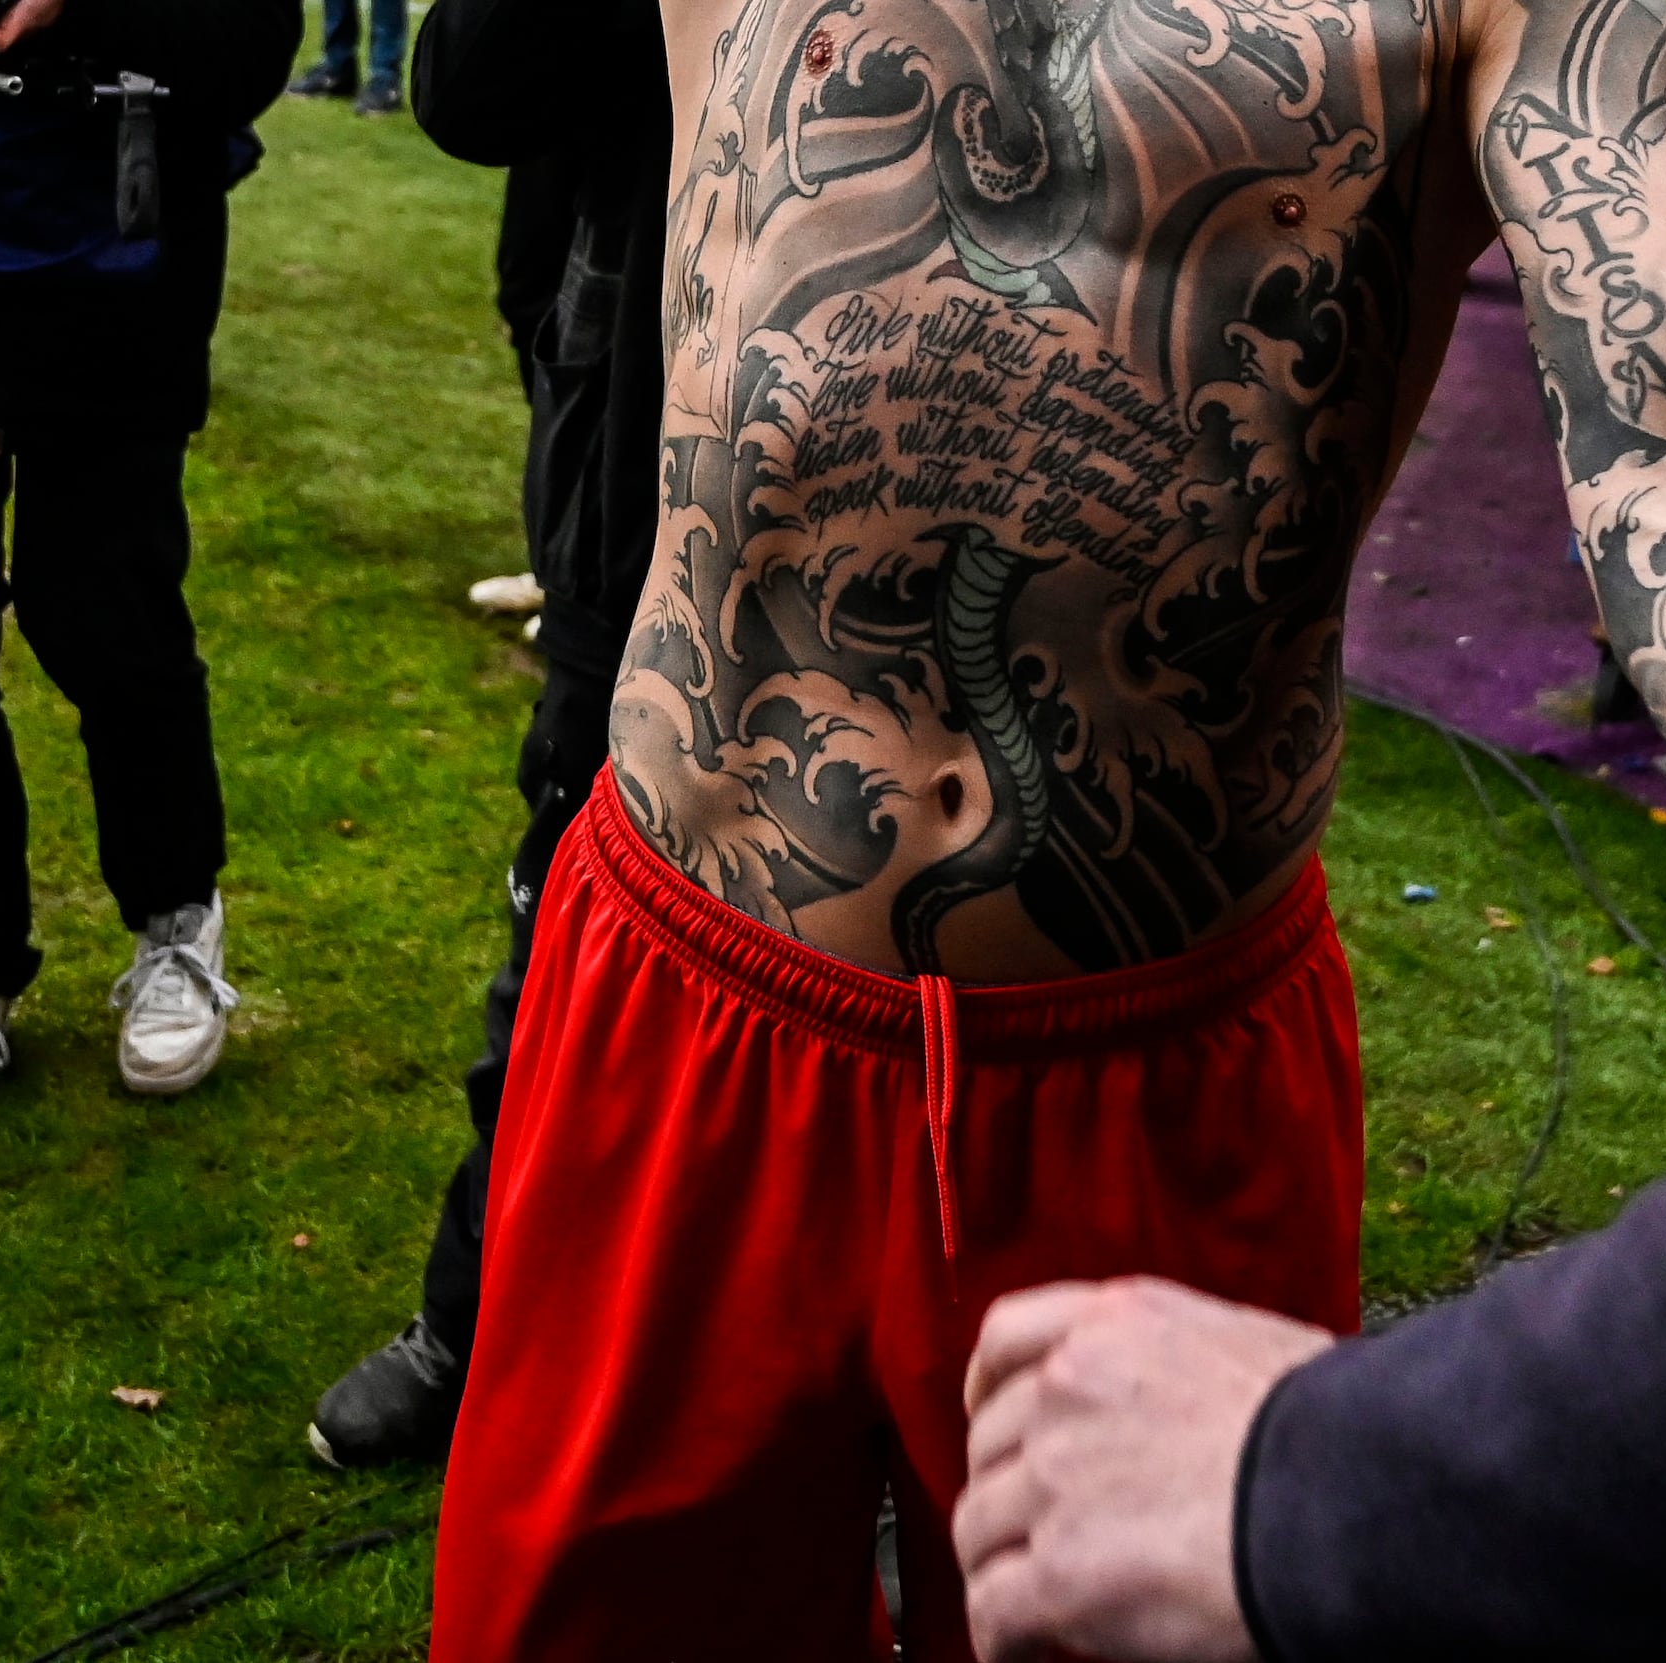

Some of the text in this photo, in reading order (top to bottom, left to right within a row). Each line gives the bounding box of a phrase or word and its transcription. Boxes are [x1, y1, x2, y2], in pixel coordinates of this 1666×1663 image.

[917, 297, 1063, 369] without
[886, 343, 1030, 406] without
[895, 402, 1039, 462] without
[895, 458, 1036, 519] without
